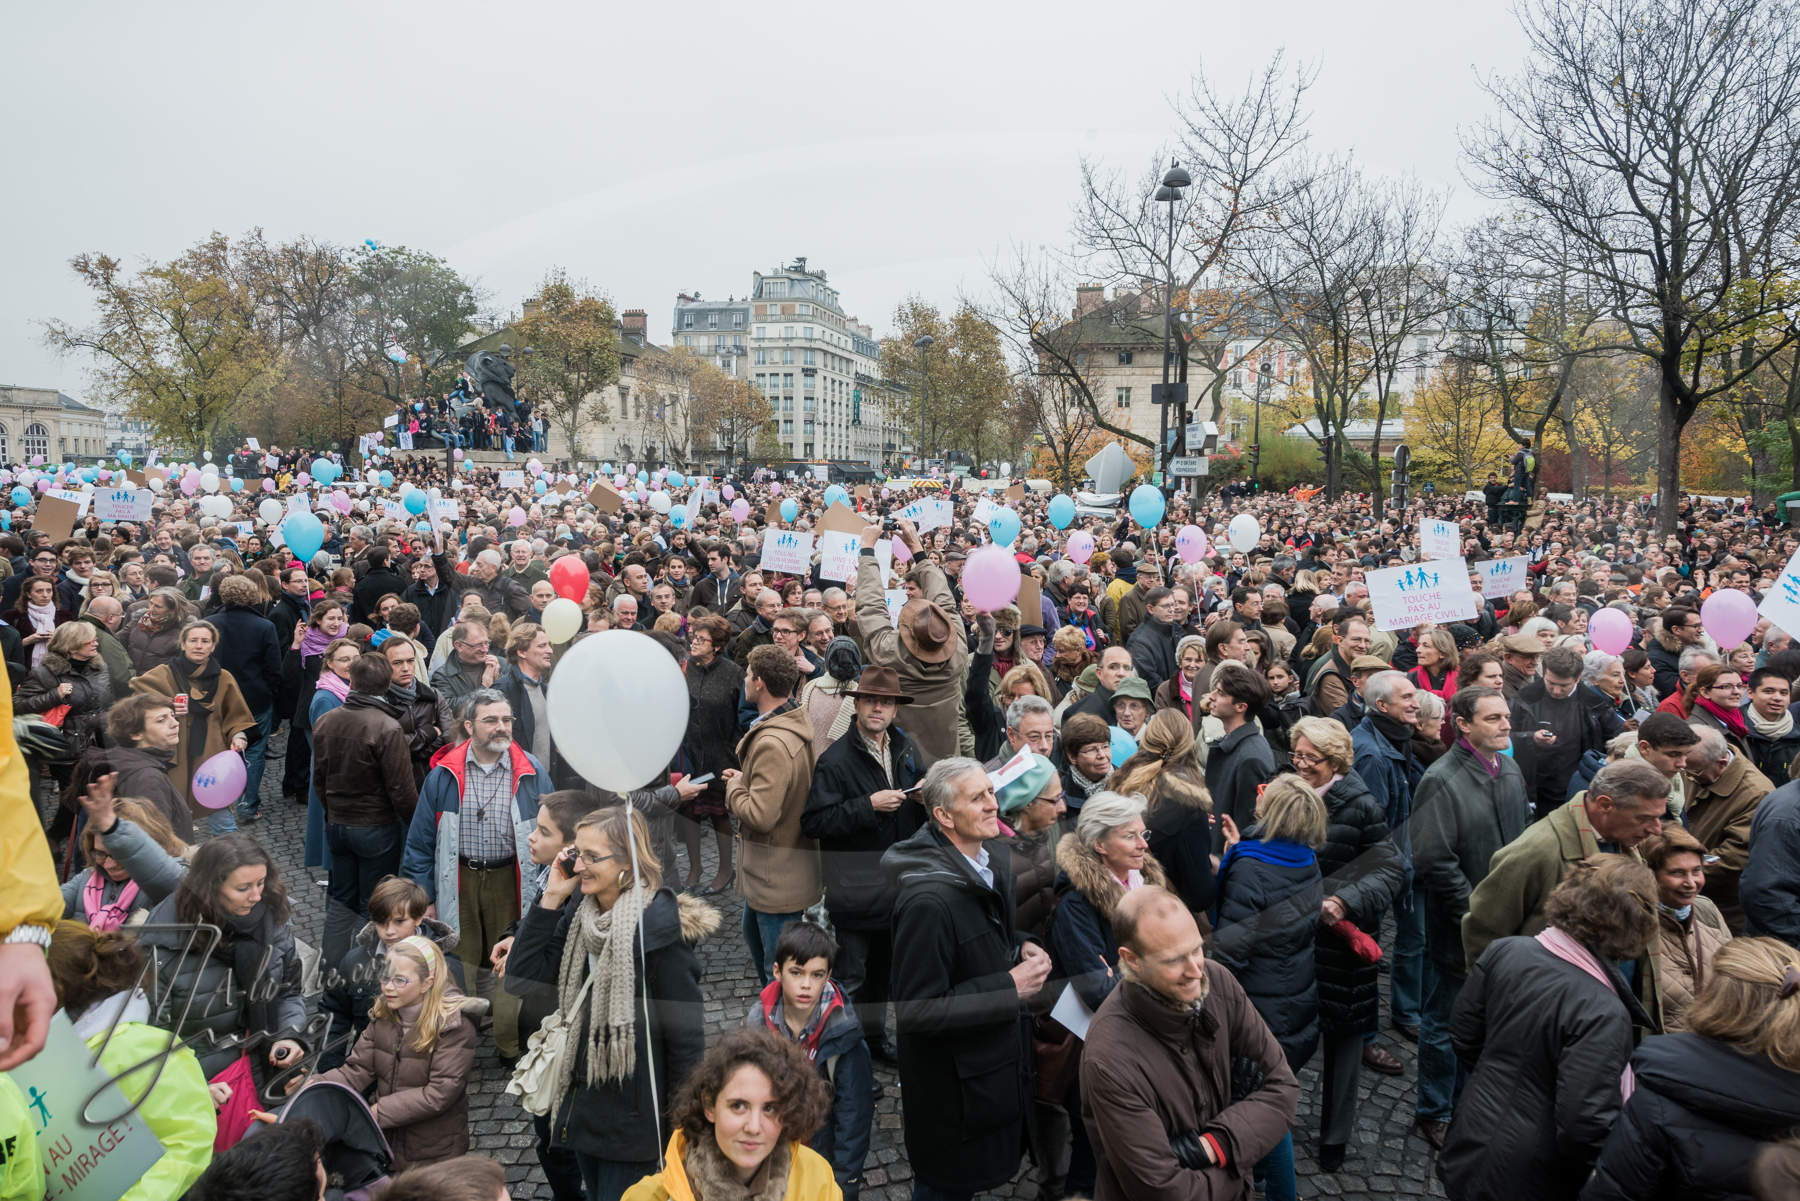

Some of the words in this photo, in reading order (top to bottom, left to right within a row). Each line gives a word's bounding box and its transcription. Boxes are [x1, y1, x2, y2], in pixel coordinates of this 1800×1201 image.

[1402, 592, 1441, 604] TOUCHE
[1408, 605, 1425, 613] PAS
[1428, 603, 1441, 611] AU
[1389, 613, 1433, 626] MARIAGE
[1435, 609, 1460, 620] CIVIL
[48, 1134, 72, 1168] AU
[61, 1123, 127, 1192] MIRAGE
